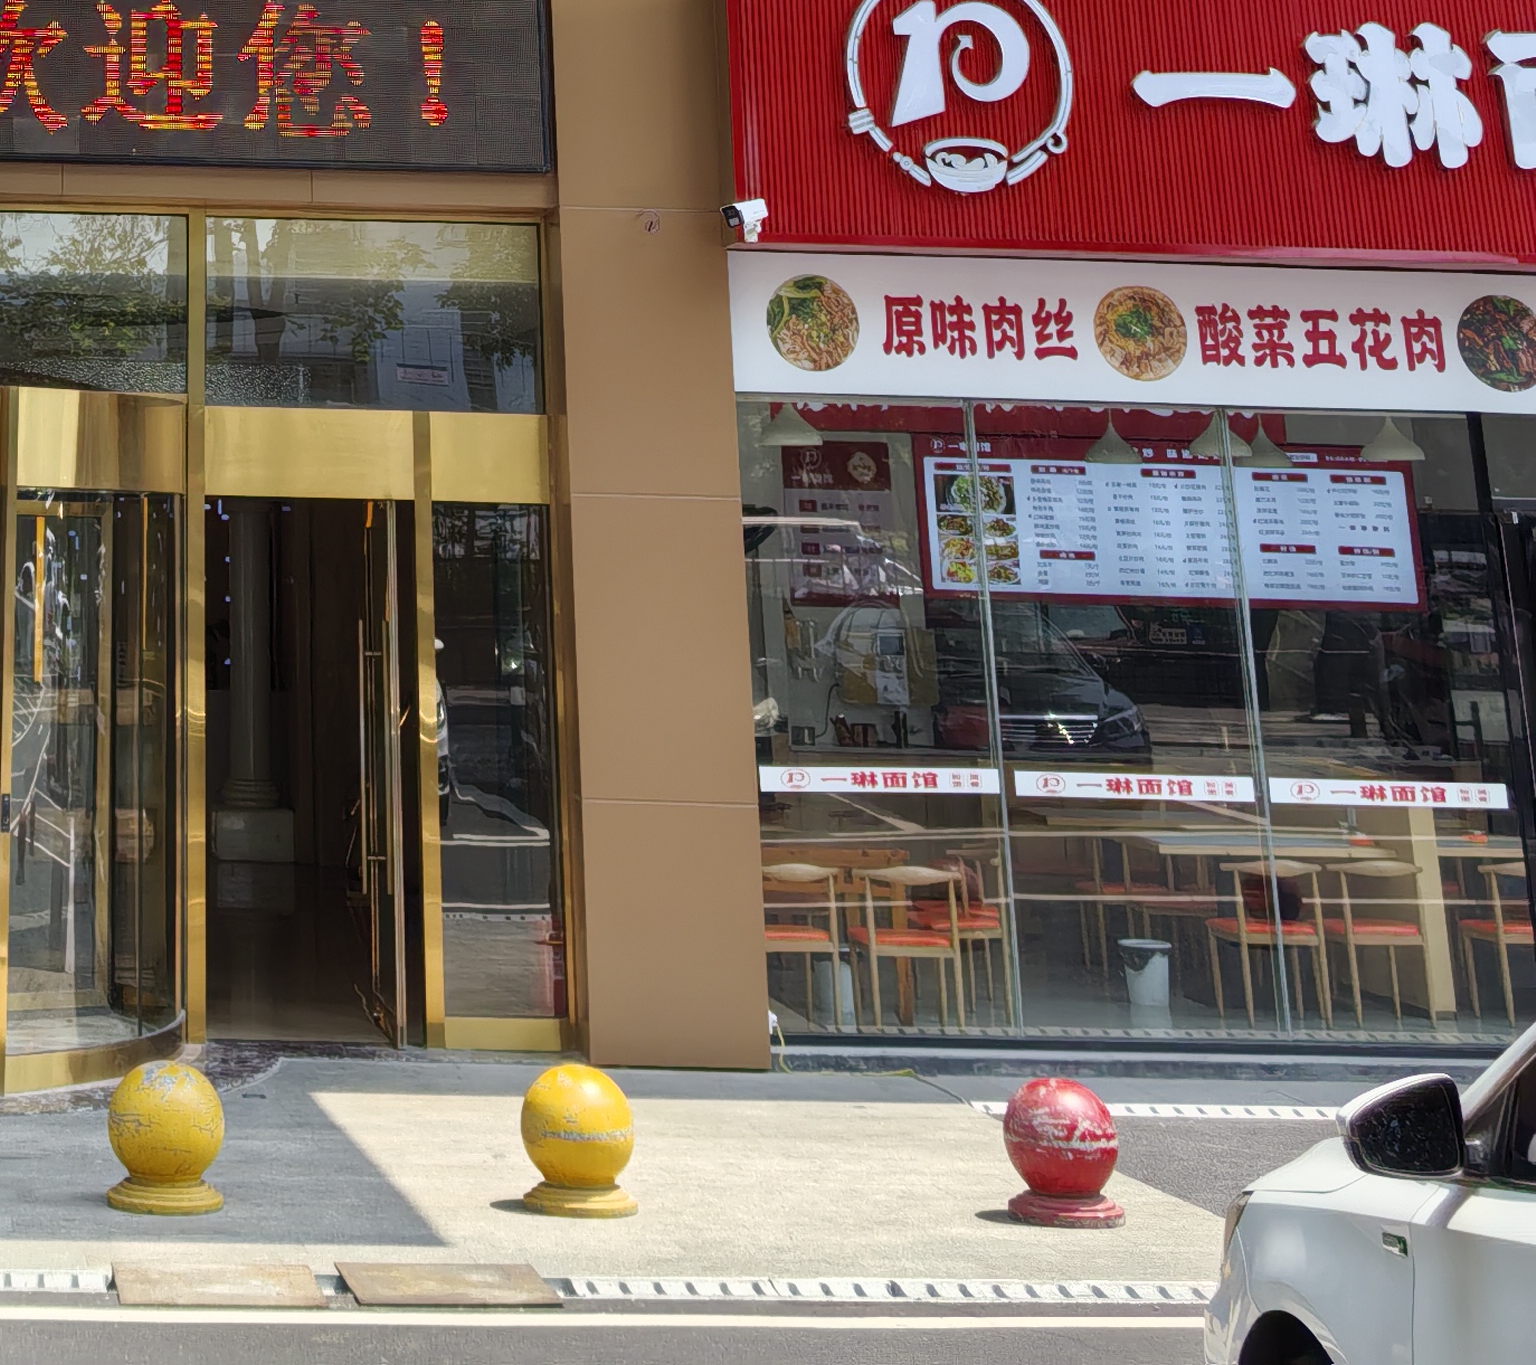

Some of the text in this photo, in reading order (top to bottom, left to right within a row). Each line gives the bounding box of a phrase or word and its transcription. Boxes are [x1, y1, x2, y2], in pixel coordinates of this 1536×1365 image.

[882, 294, 1079, 362] 原味肉丝
[1195, 303, 1448, 372] 酸菜五花肉
[820, 771, 939, 789] 一琳面馆
[1075, 777, 1194, 797] 一琳面馆
[1330, 784, 1448, 804] 一琳面馆
